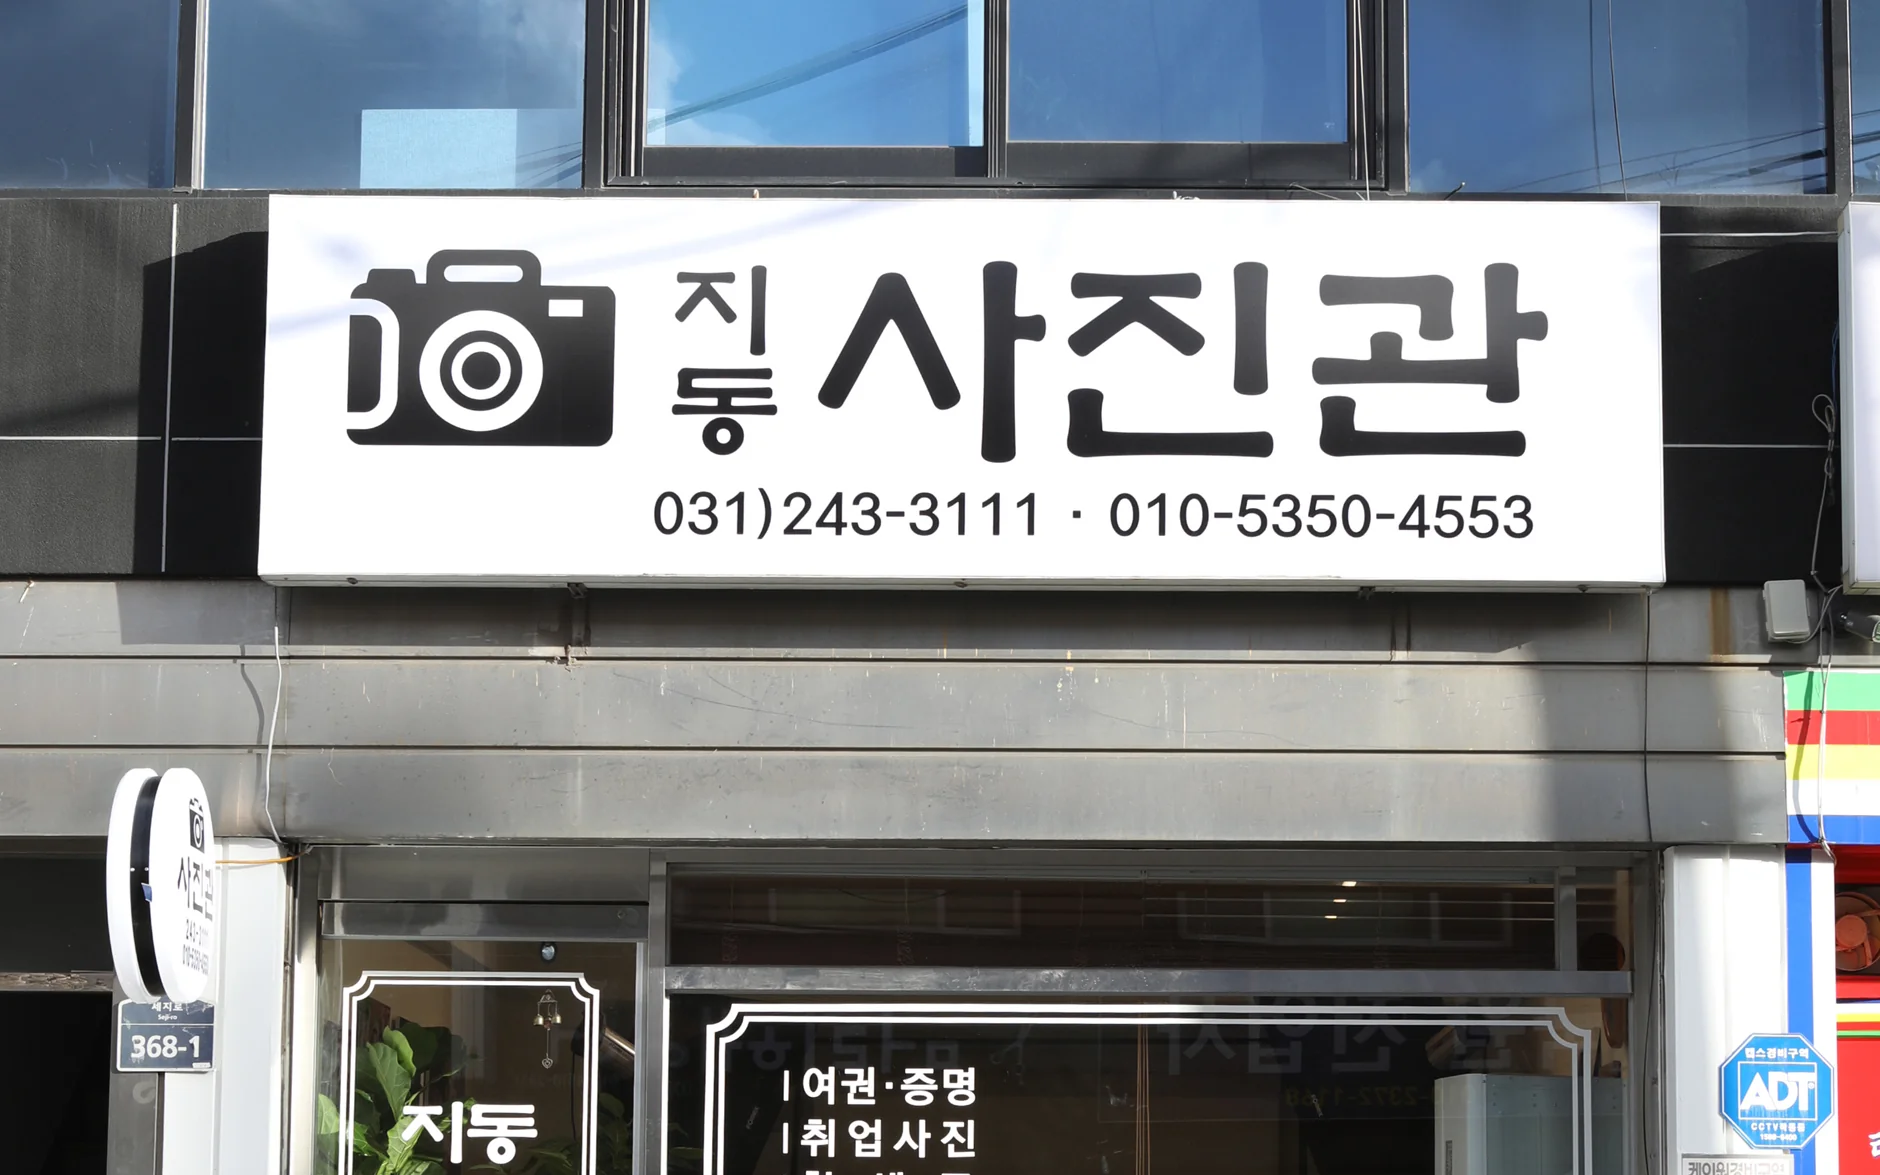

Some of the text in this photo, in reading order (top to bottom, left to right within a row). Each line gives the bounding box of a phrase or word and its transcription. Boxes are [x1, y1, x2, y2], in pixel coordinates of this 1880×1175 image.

[672, 261, 1547, 462] 지동 사진관
[654, 488, 1533, 539] 031)243-3111 010-5350-4553
[177, 856, 214, 922] 사진관
[151, 1001, 184, 1012] 세지로
[130, 1034, 200, 1059] 368-1
[1740, 1071, 1815, 1111] ADT
[402, 1102, 537, 1164] 지동
